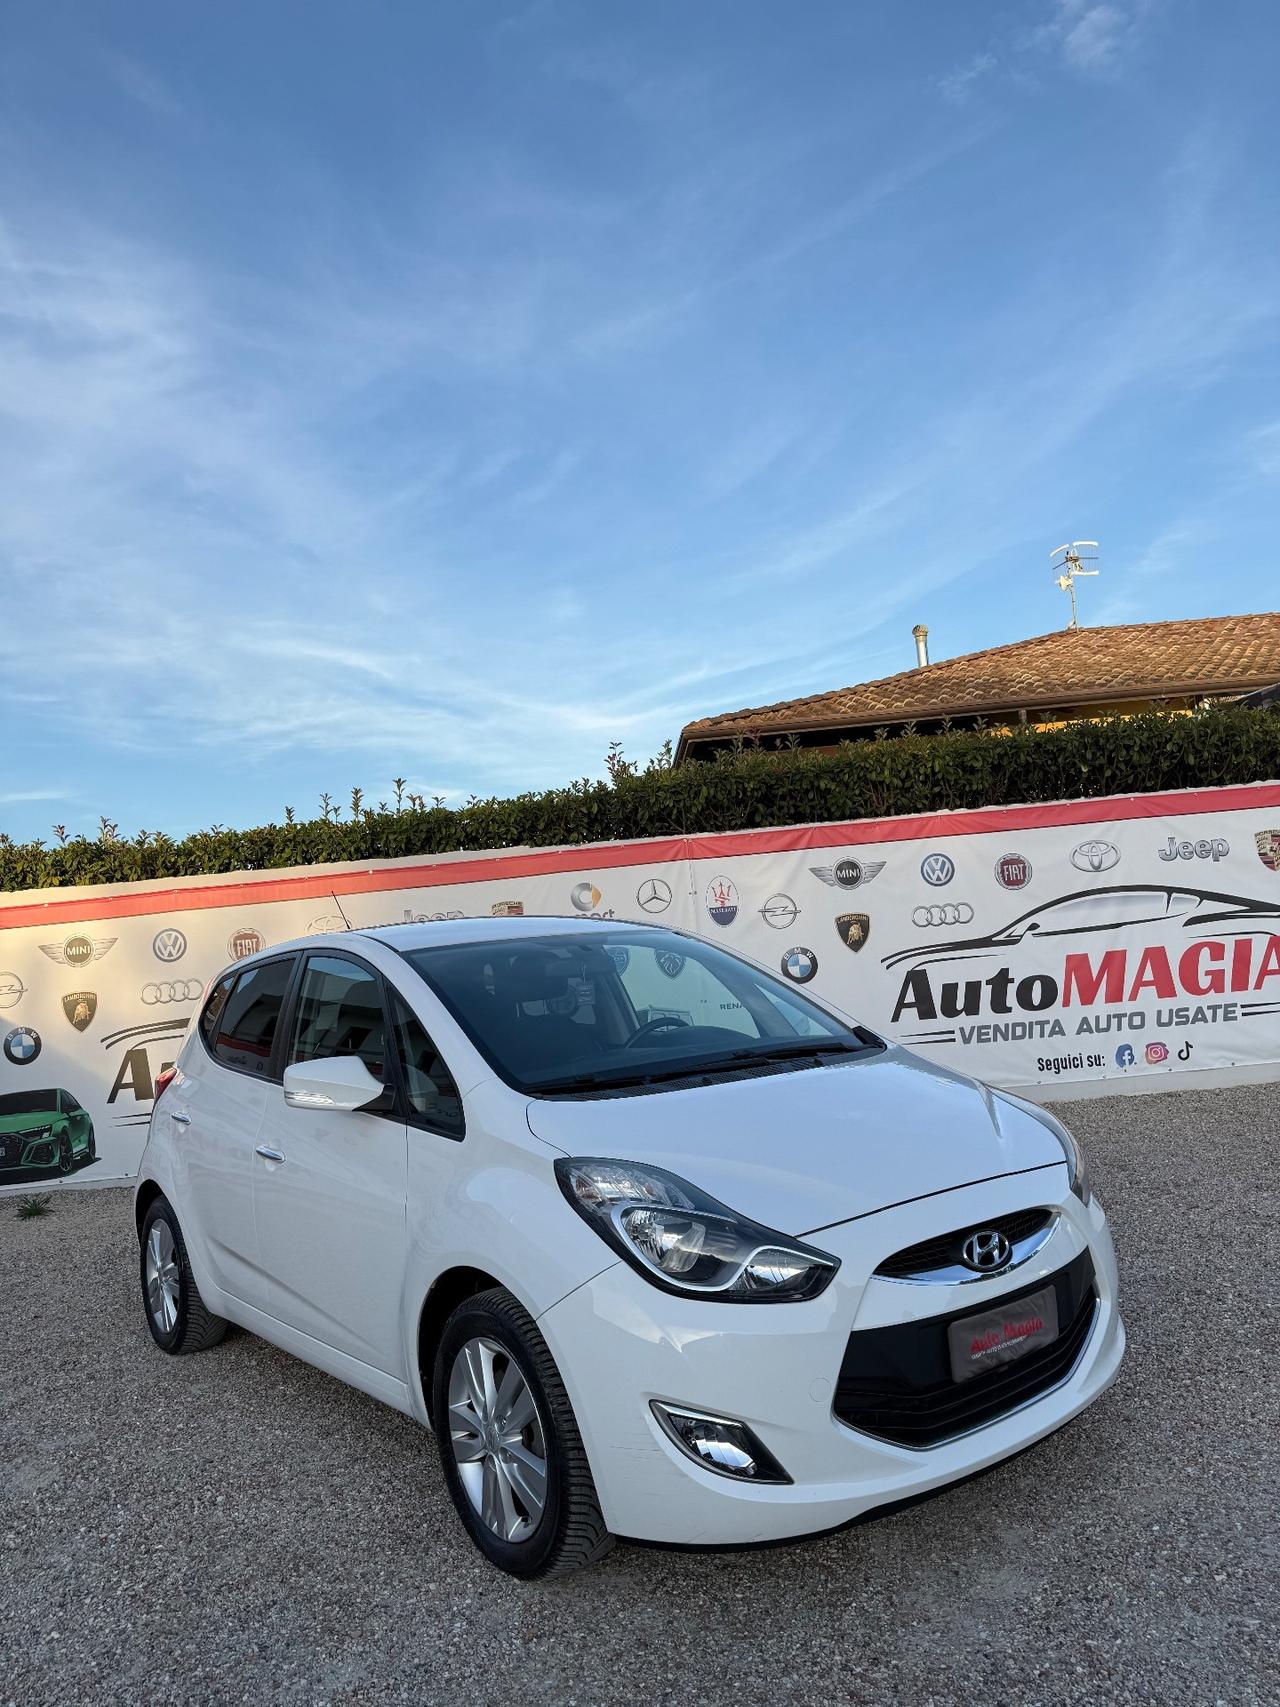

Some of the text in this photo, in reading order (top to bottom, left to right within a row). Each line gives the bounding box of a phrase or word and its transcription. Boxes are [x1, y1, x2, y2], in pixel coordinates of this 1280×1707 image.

[1158, 837, 1230, 862] Jeep
[837, 867, 861, 879] MINI
[1003, 863, 1025, 882] FIAT
[67, 944, 91, 956] MINI
[236, 938, 259, 957] FIAT
[784, 946, 814, 960] BMW
[959, 1003, 1238, 1045] VENDITA AUTO USATE
[7, 1027, 38, 1041] BMW
[1037, 1054, 1106, 1074] Seguici su:
